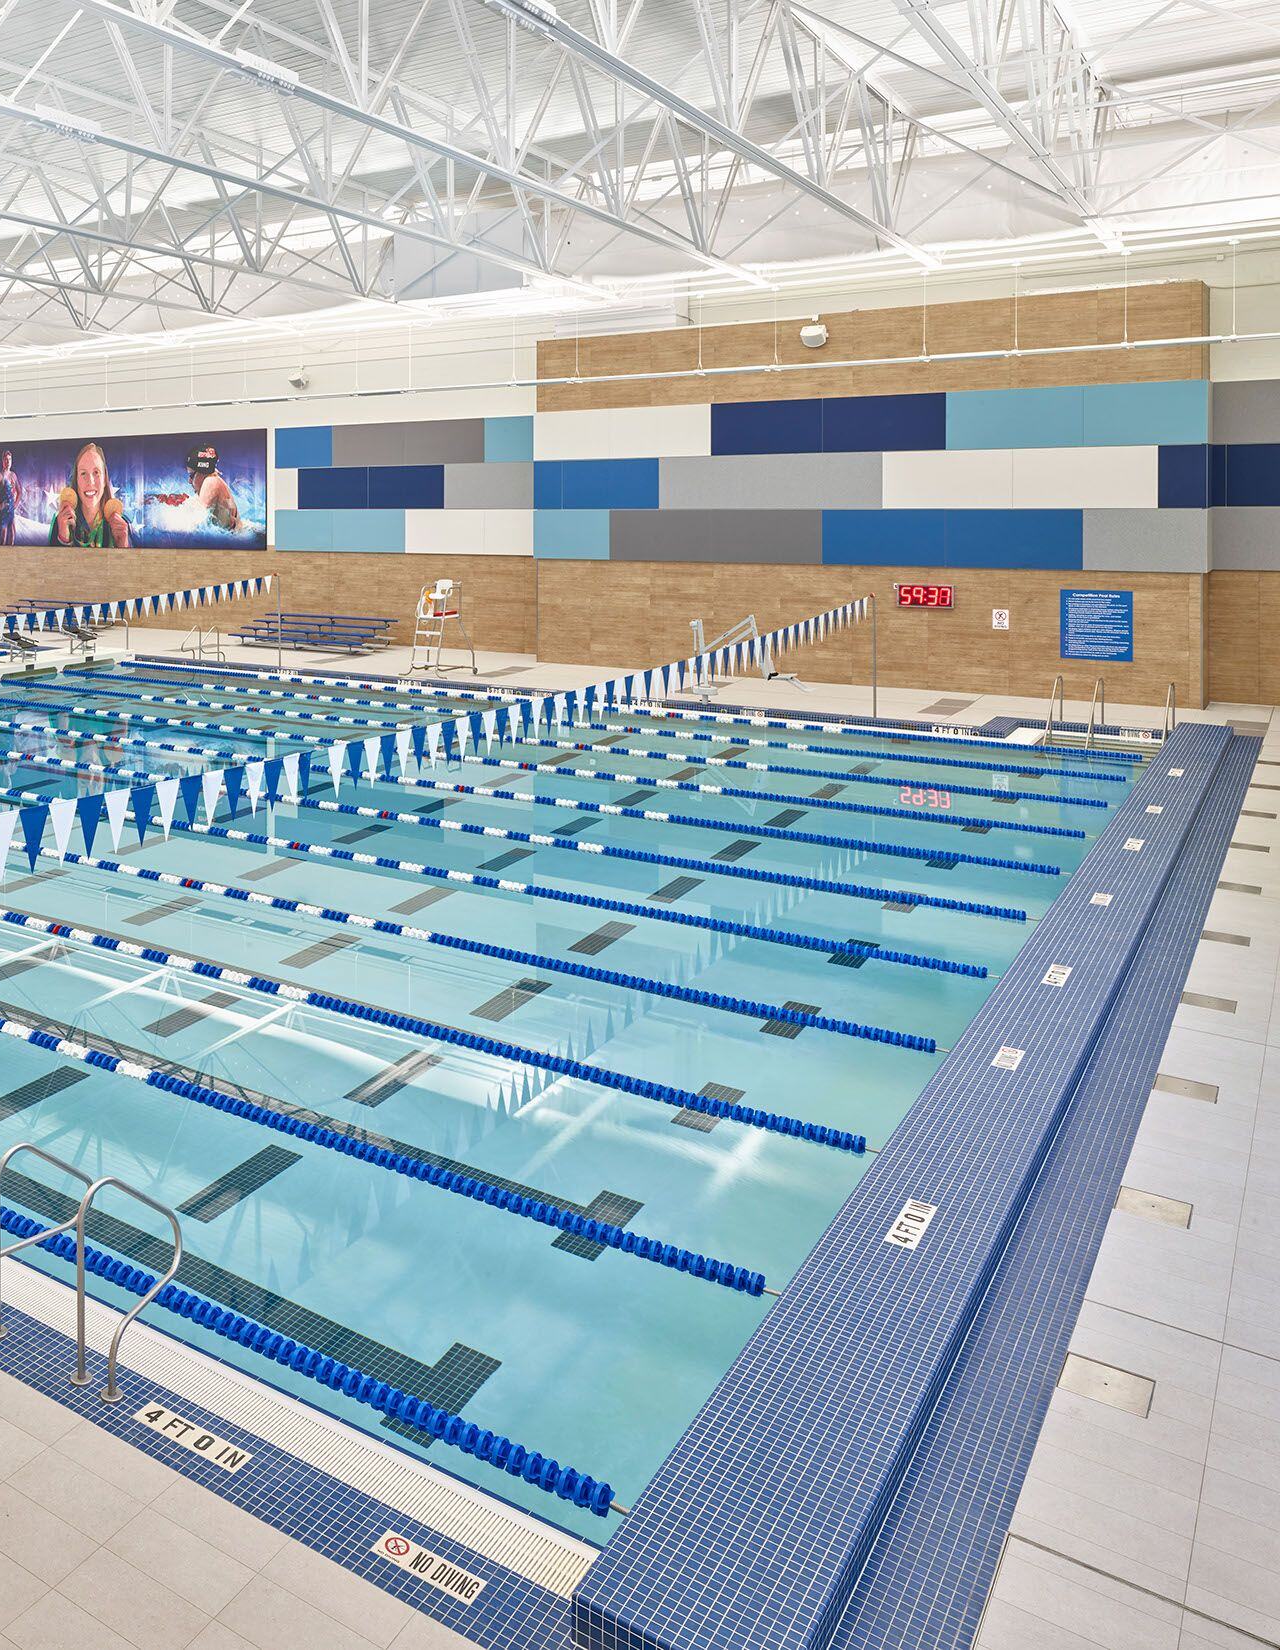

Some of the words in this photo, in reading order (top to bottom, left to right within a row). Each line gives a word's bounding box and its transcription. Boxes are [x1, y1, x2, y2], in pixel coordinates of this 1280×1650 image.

[909, 1201, 932, 1214] IN
[904, 1213, 925, 1223] 0
[896, 1221, 921, 1236] FT
[892, 1234, 913, 1243] 4
[145, 1410, 165, 1423] 4
[162, 1418, 195, 1438] FT
[193, 1434, 215, 1451] 0
[215, 1446, 246, 1469] IN
[409, 1551, 434, 1574] NO
[430, 1562, 480, 1600] DIVING
